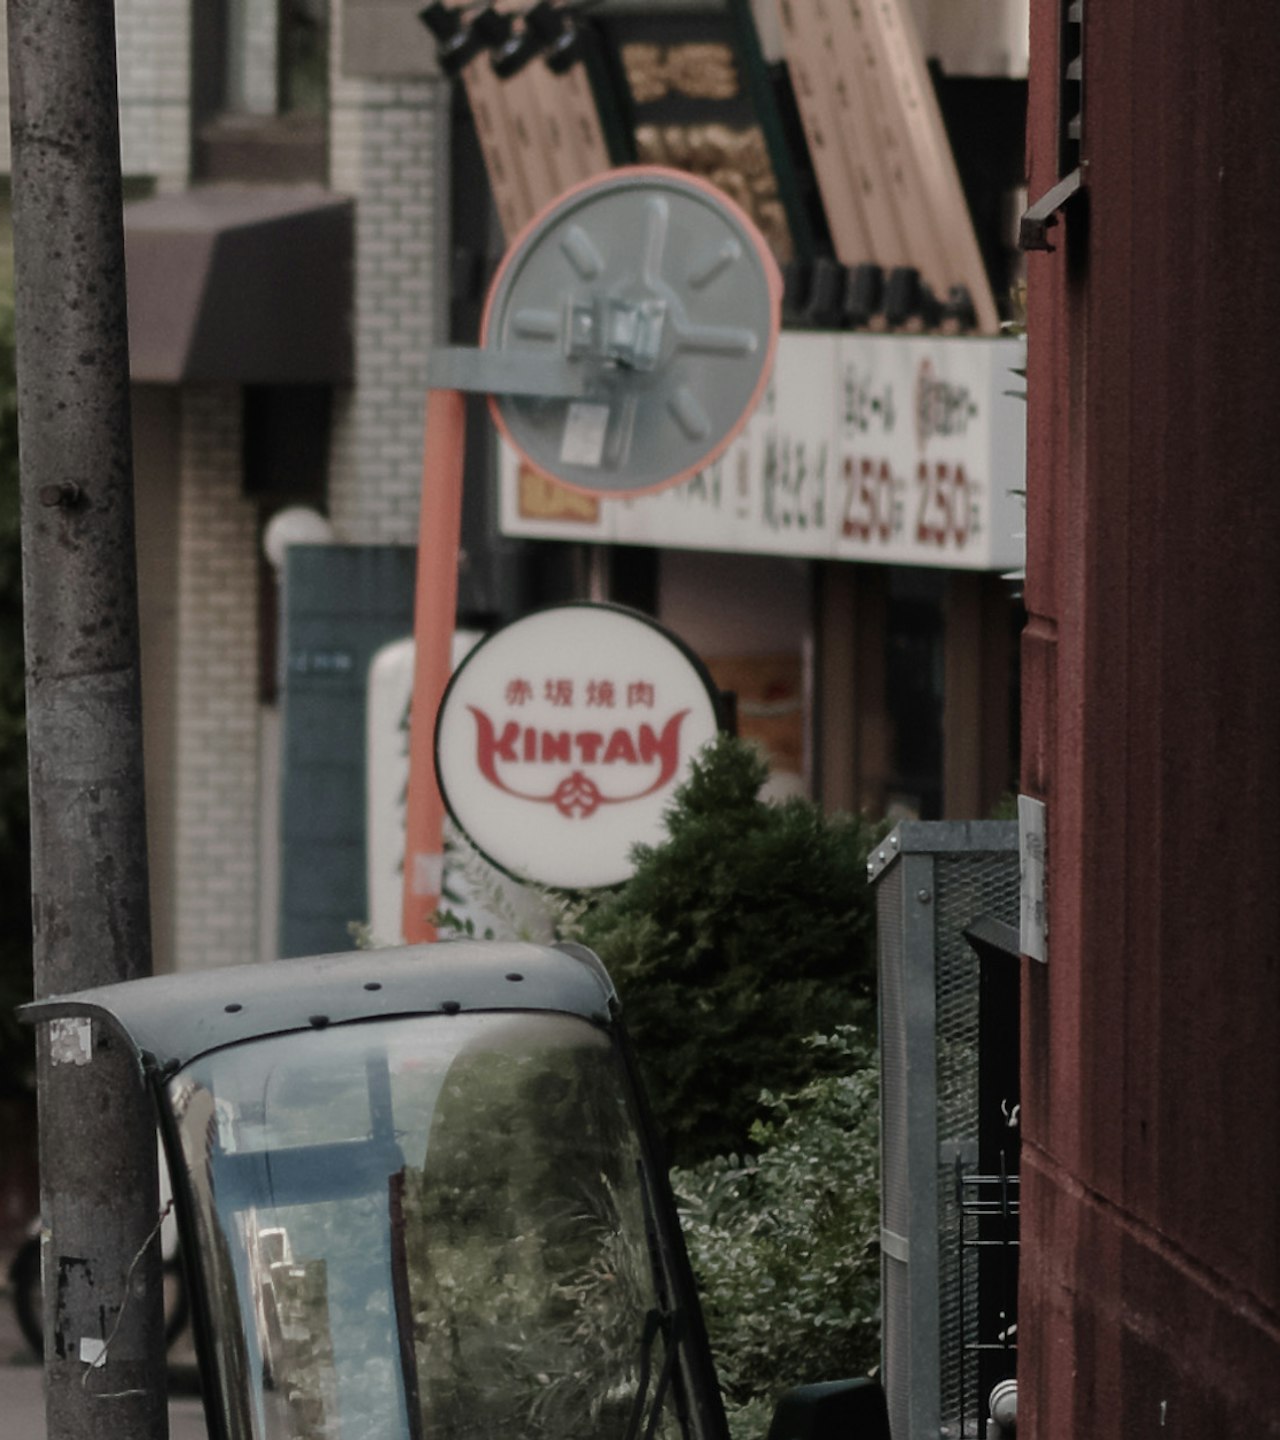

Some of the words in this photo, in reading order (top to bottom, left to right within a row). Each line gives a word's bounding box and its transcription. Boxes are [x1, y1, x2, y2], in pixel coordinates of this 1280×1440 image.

[505, 678, 655, 708] 赤坂焼肉
[469, 708, 686, 770] KINTAN
